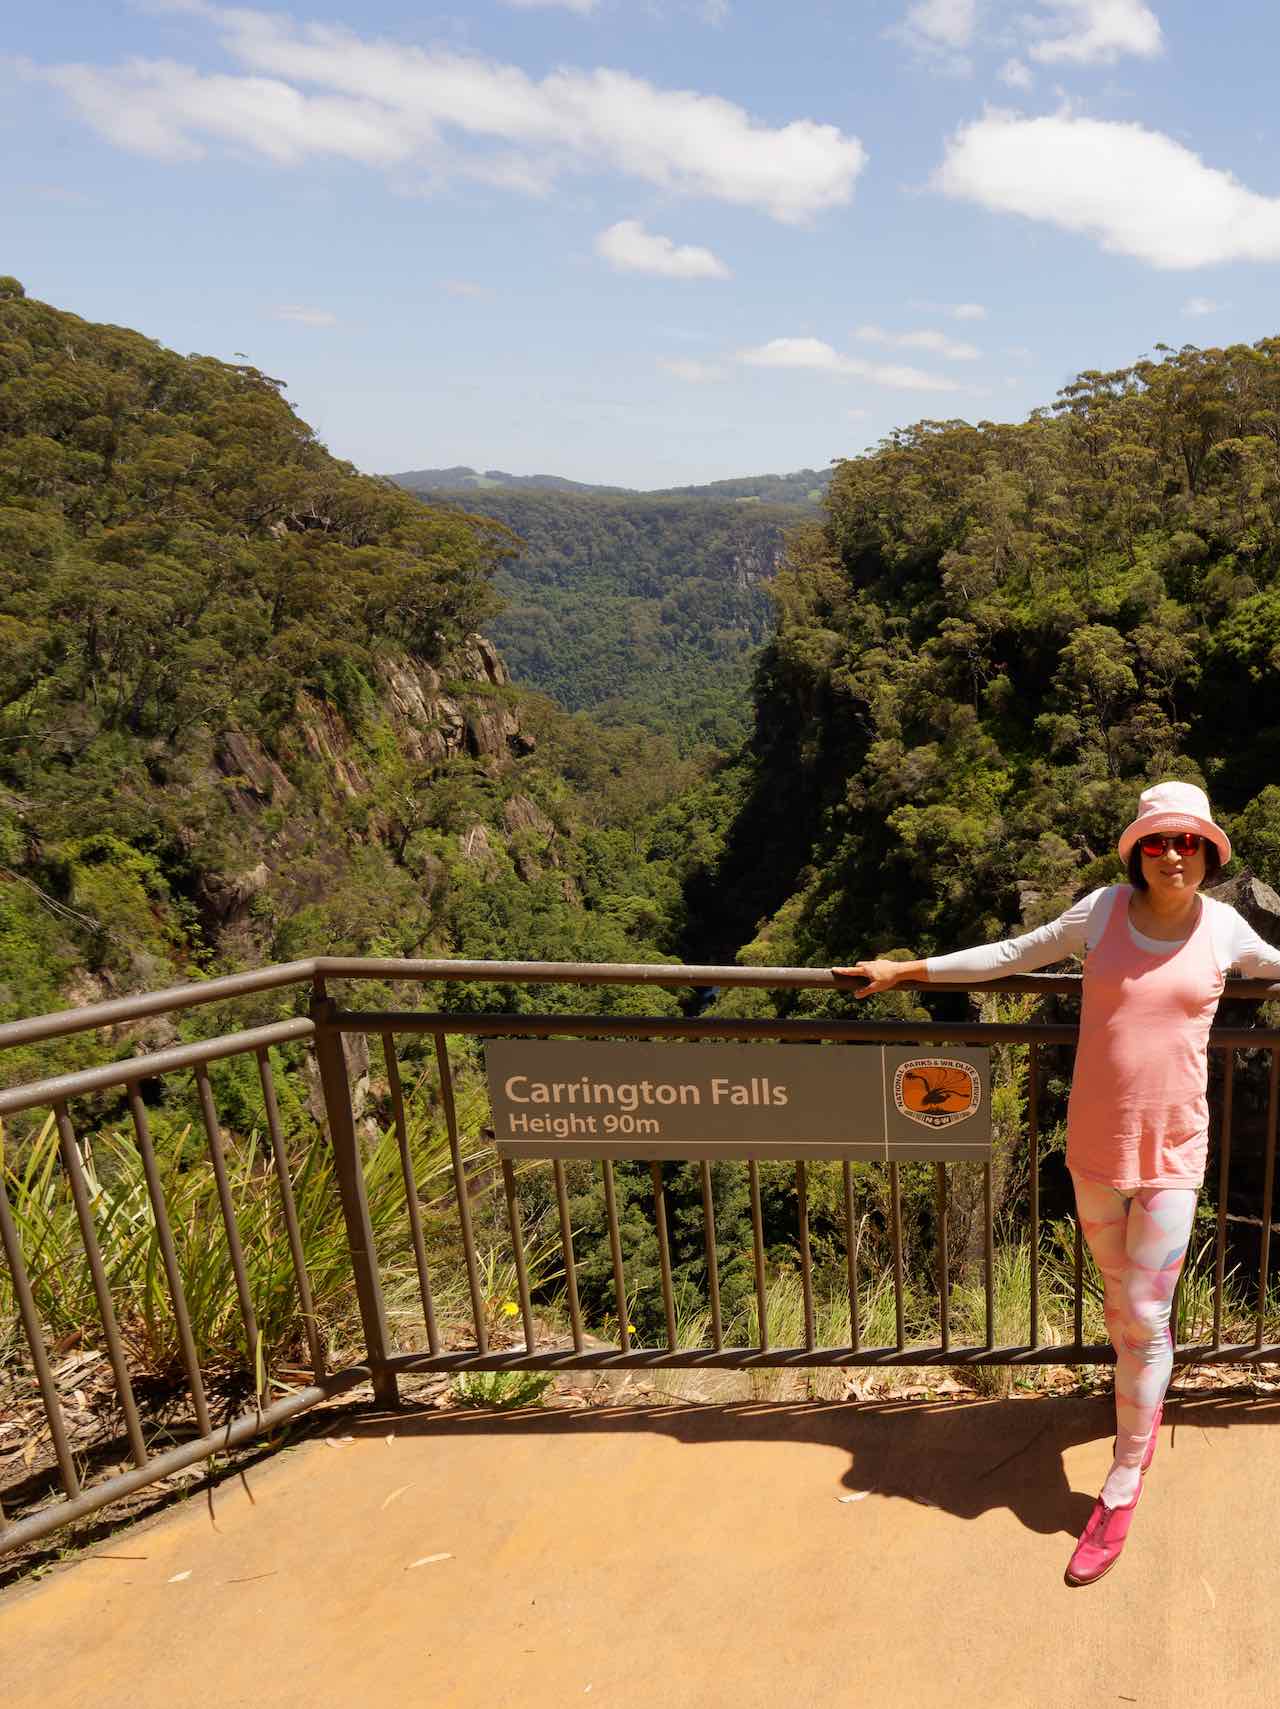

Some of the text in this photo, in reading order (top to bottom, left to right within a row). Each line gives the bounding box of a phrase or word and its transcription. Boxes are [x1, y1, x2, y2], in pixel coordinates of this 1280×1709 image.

[904, 1060, 933, 1069] PARKS
[505, 1076, 788, 1111] Carrington Falls
[509, 1113, 659, 1136] Height 90m
[925, 1115, 951, 1126] NSW
